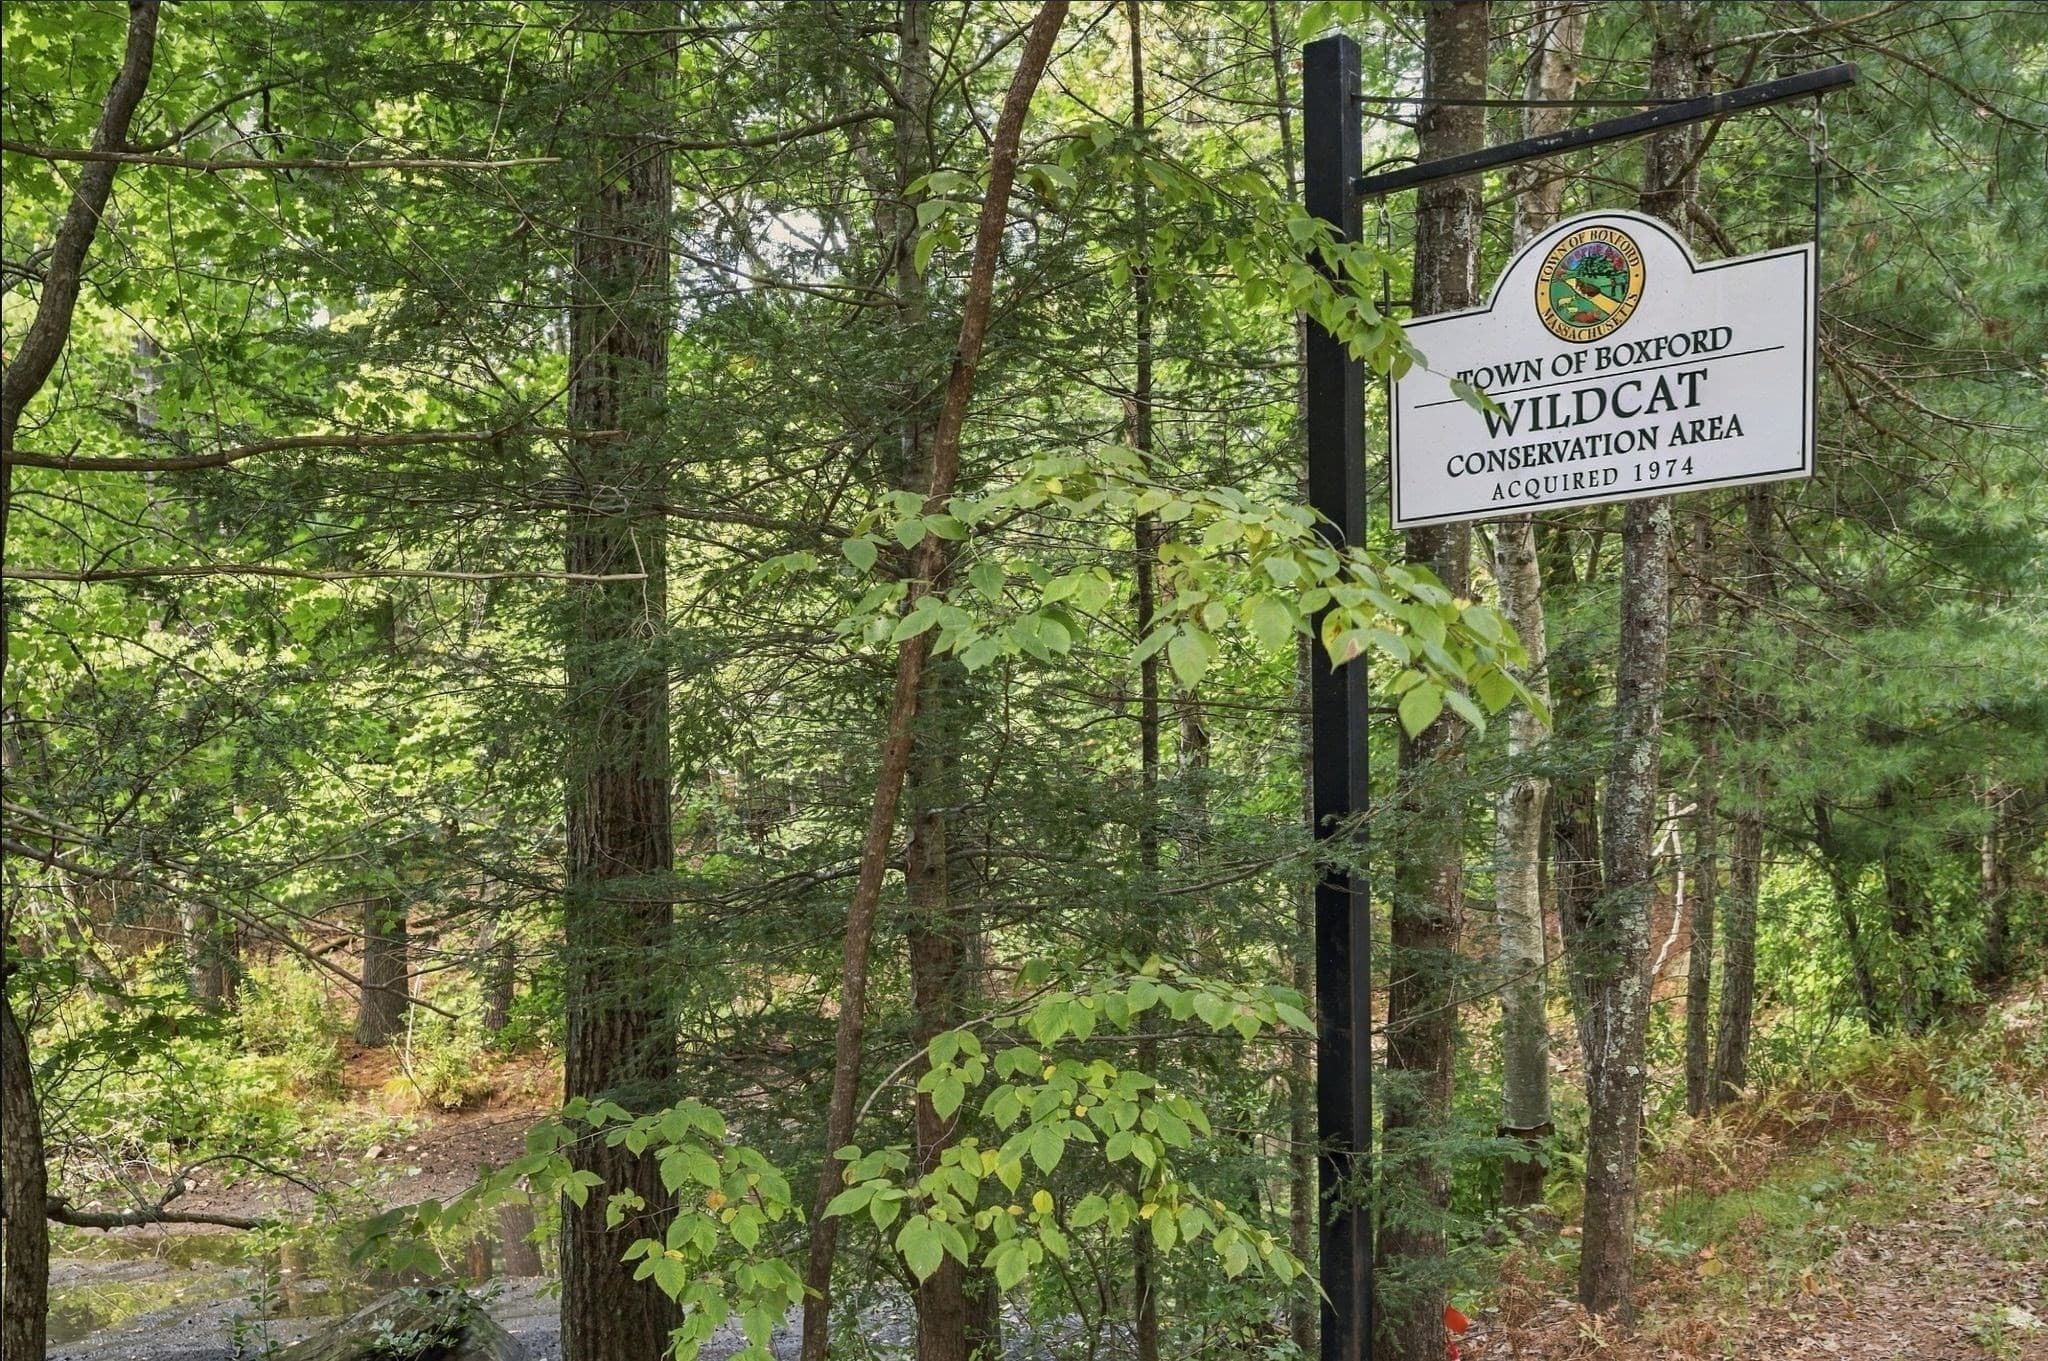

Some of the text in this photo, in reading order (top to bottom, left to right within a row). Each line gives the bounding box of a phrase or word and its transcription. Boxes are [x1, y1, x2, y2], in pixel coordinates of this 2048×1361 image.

[1569, 232, 1585, 248] OF
[1590, 230, 1640, 267] BOXFORD
[1544, 294, 1638, 340] MASSACHUSETTS
[1457, 326, 1733, 389] TOWN OF BOXFORD
[1482, 368, 1708, 439] WILDCAT
[1447, 414, 1744, 477] CONSERVATION AREA
[1492, 456, 1693, 500] ACQUIRED 1974
